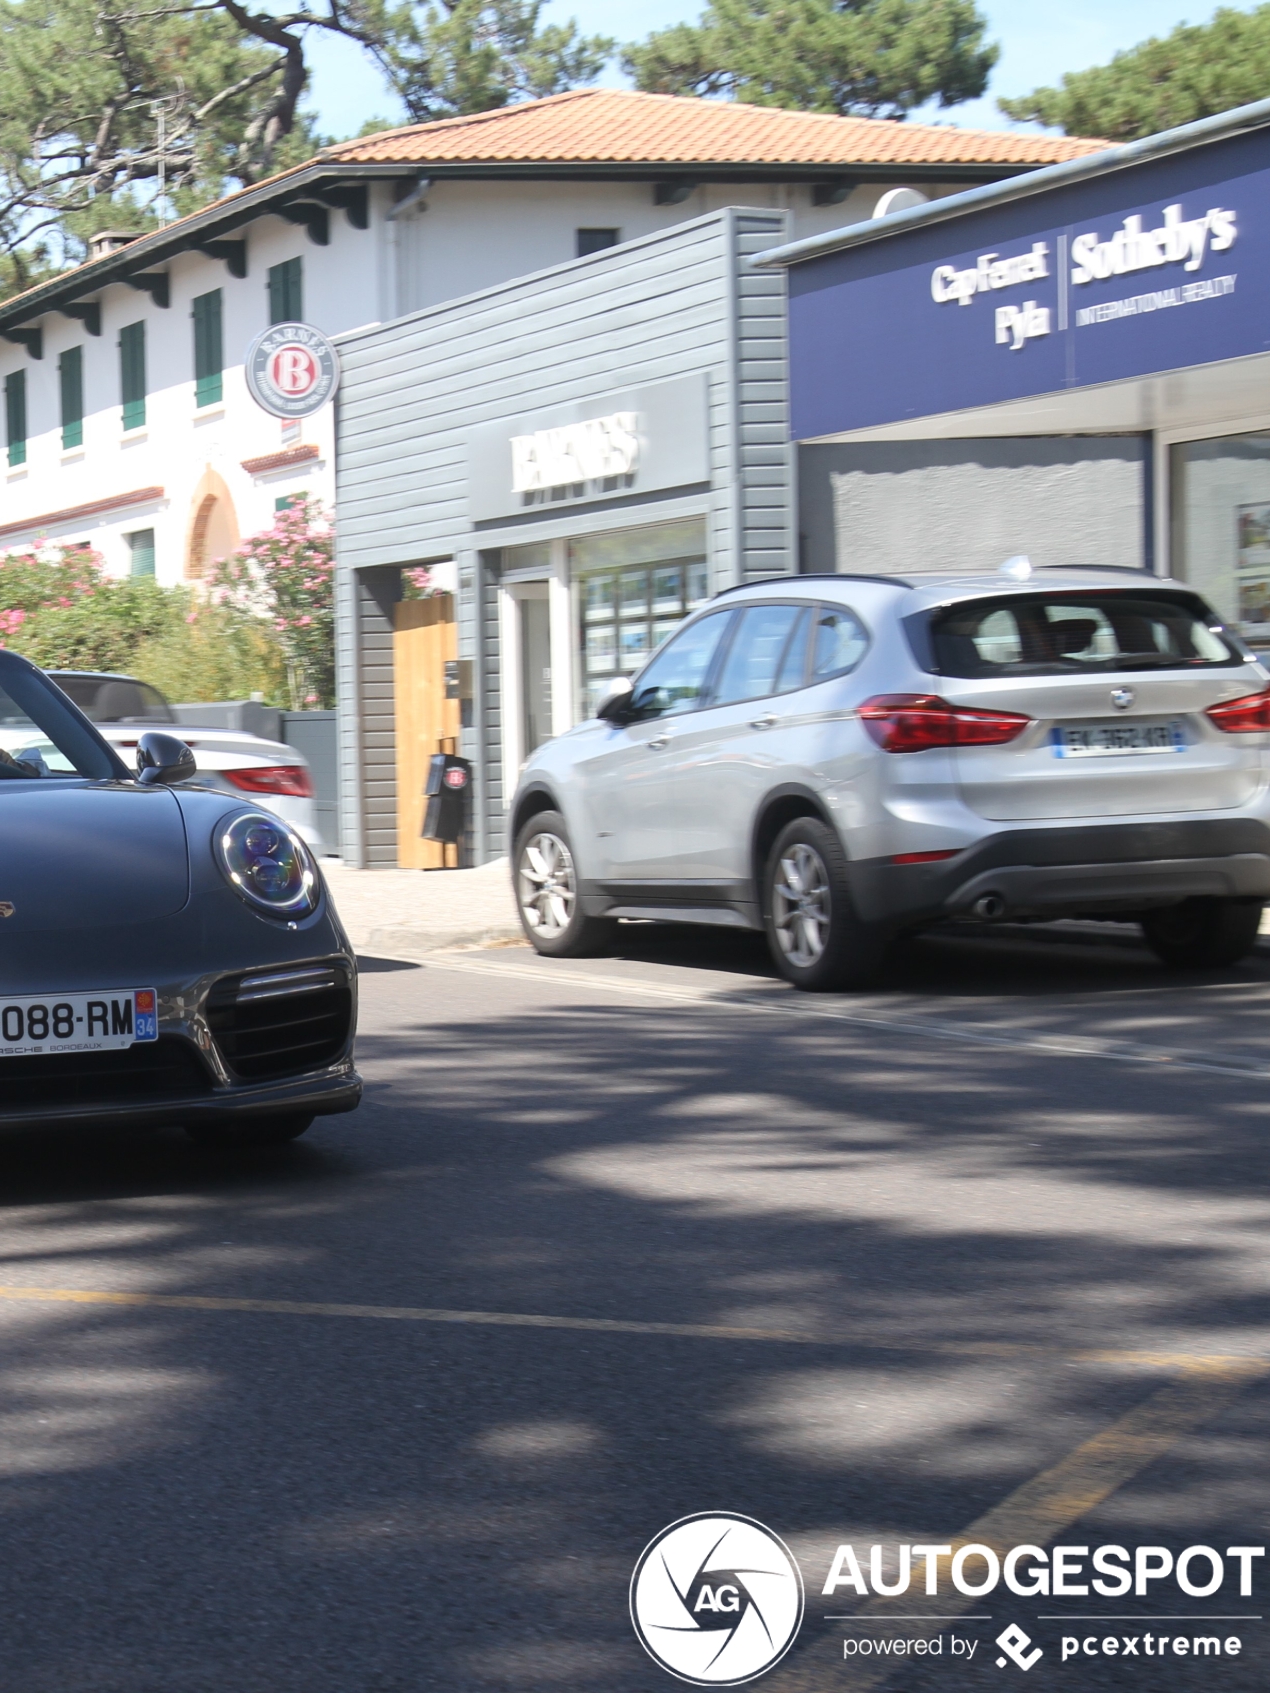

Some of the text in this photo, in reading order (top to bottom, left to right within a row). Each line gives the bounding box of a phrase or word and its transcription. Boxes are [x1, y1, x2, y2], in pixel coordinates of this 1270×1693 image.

[1071, 203, 1238, 285] Sotheby's
[995, 300, 1051, 350] Pyla
[1075, 286, 1184, 327] INTERNATIONAL
[279, 350, 311, 391] B
[49, 1042, 103, 1052] BORDEAUX
[136, 1017, 154, 1036] 34
